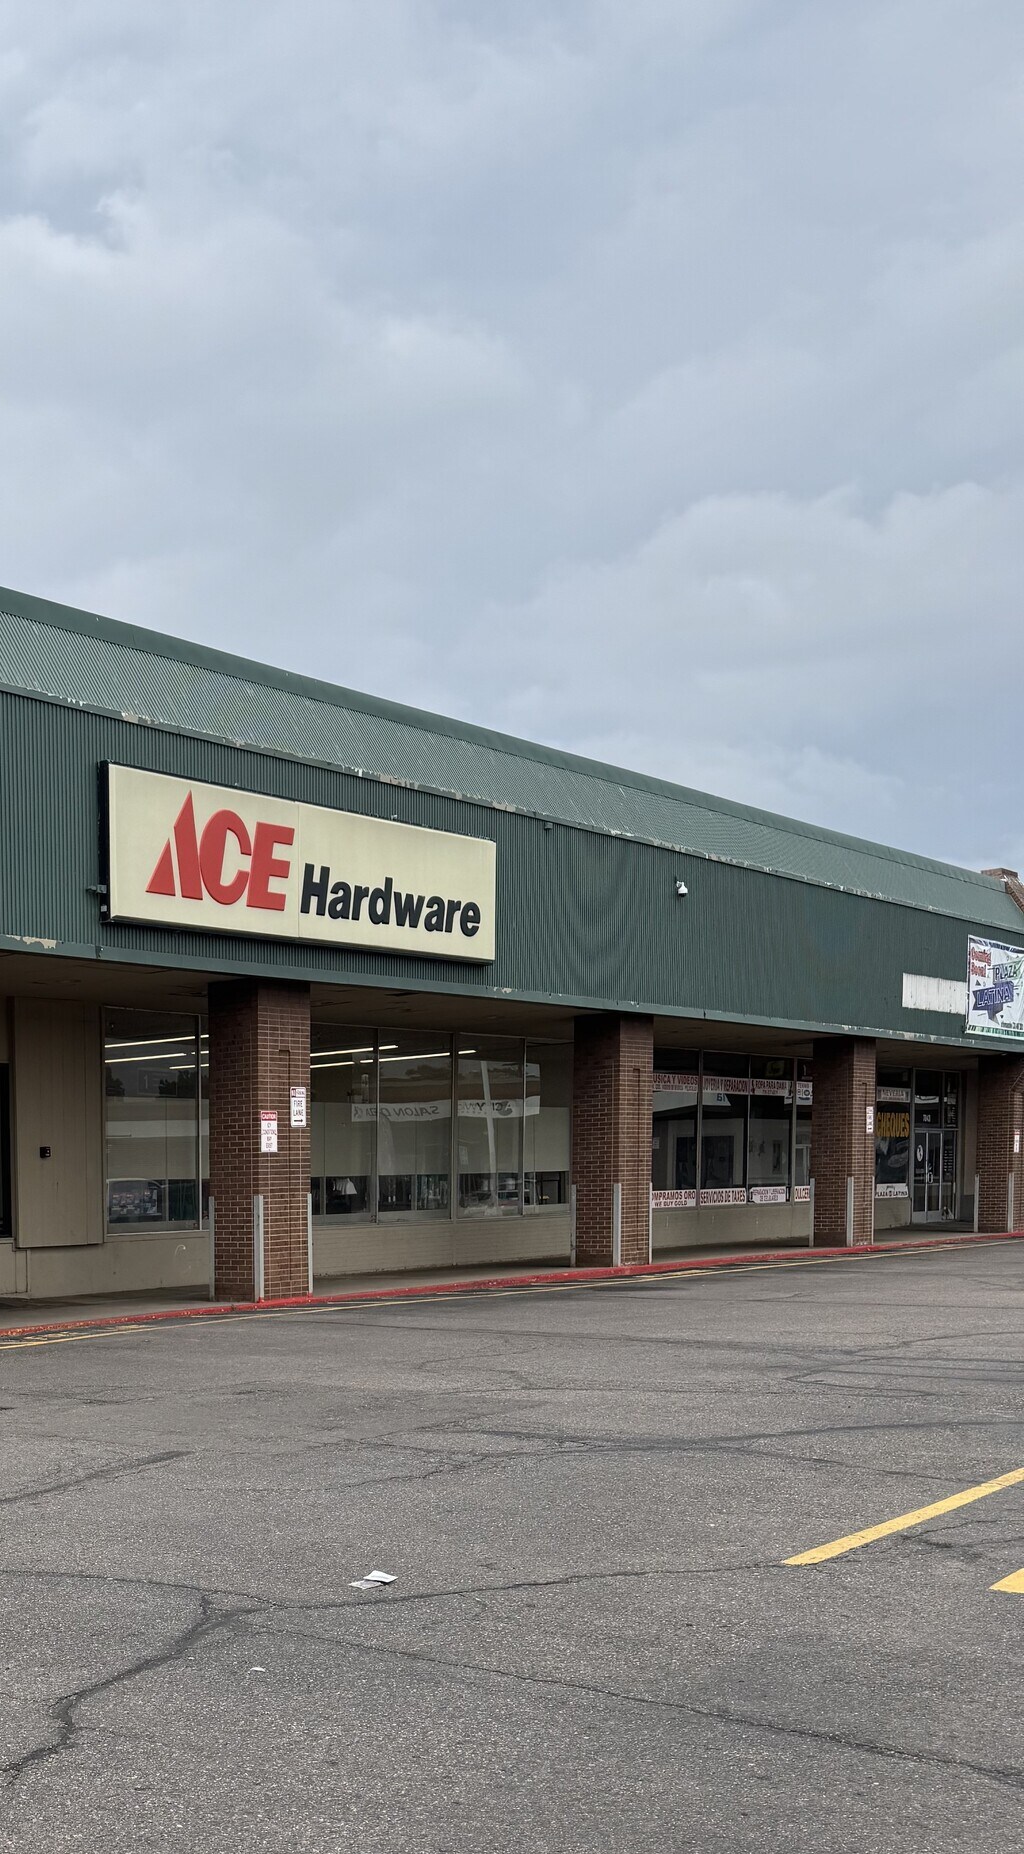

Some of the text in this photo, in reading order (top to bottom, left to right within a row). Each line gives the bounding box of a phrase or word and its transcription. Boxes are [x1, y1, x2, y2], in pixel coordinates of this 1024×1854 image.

[145, 789, 481, 937] ACE Hardware
[977, 986, 1010, 1007] LATINA
[654, 1074, 670, 1084] USICA
[677, 1076, 698, 1085] VIDEOS
[877, 1112, 910, 1137] CHEQUES
[652, 1191, 695, 1200] OMPRAMOS ORO
[701, 1190, 745, 1204] SERVICIOS DE TAXES
